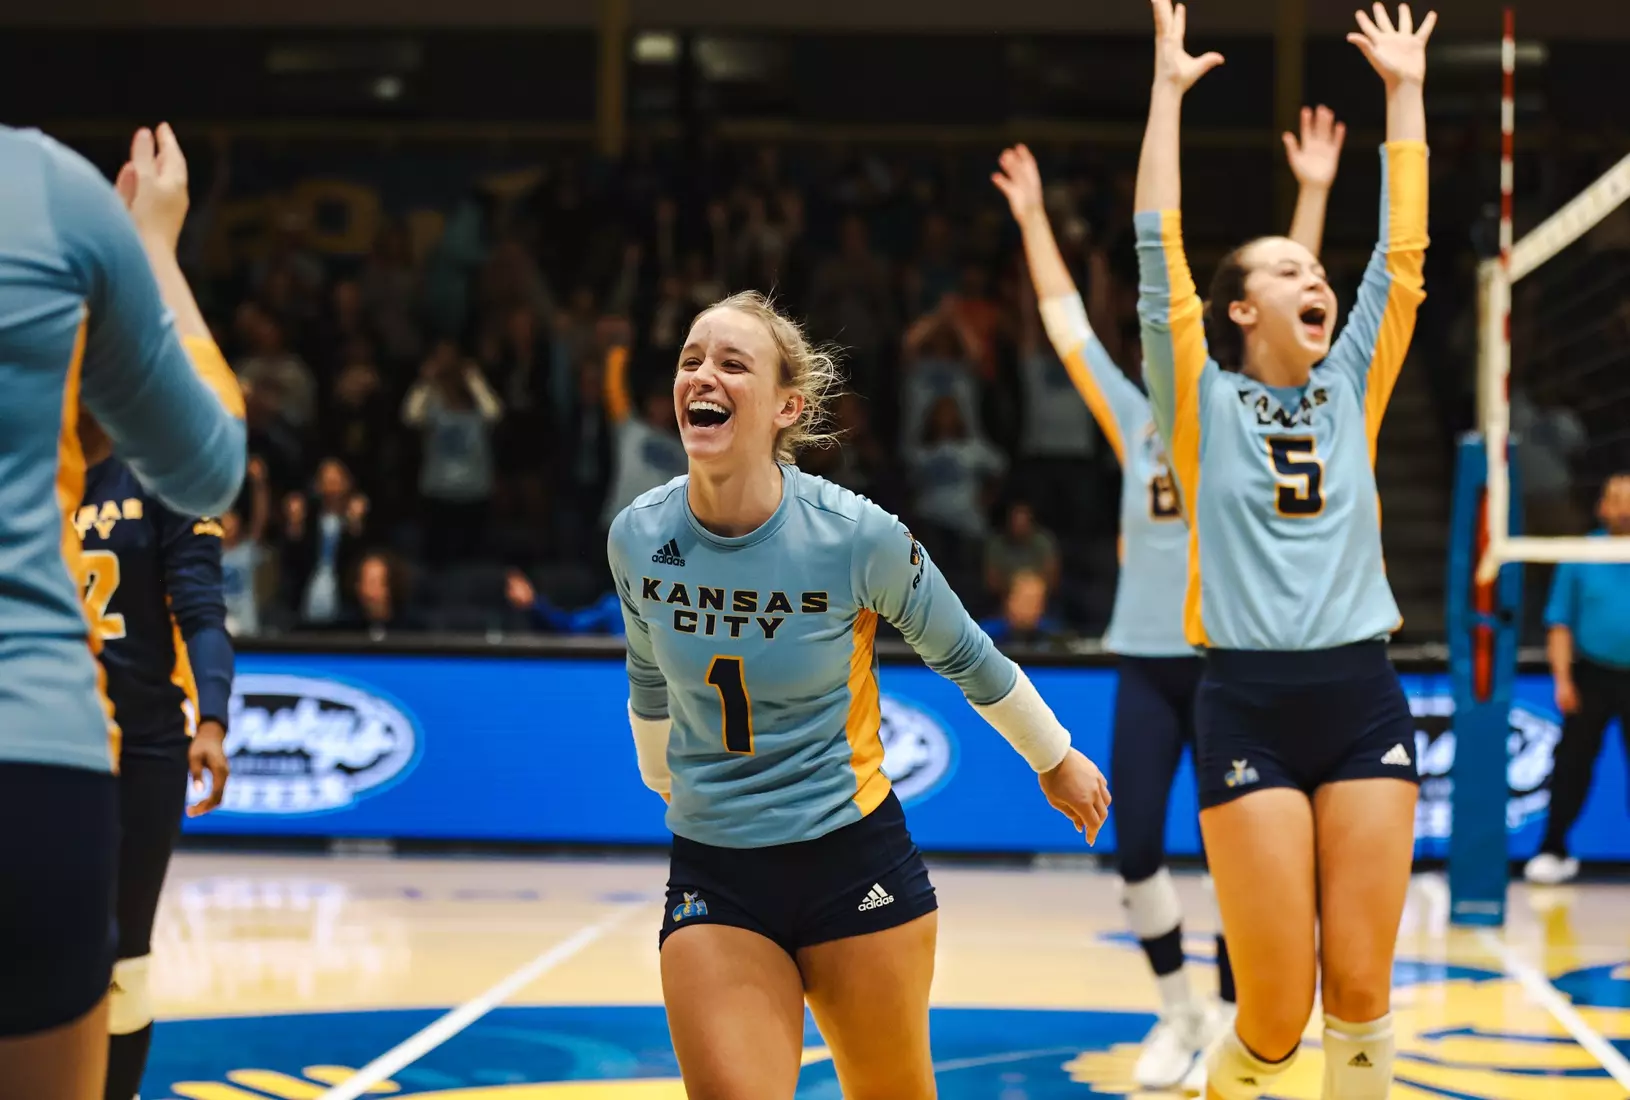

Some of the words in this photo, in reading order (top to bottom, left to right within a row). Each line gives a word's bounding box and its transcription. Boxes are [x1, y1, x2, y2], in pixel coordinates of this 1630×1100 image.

[1265, 435, 1327, 518] 5
[652, 553, 686, 567] adidas
[642, 576, 829, 614] KANSAS
[673, 609, 785, 640] CITY
[705, 655, 754, 756] 1
[858, 894, 894, 911] adidas
